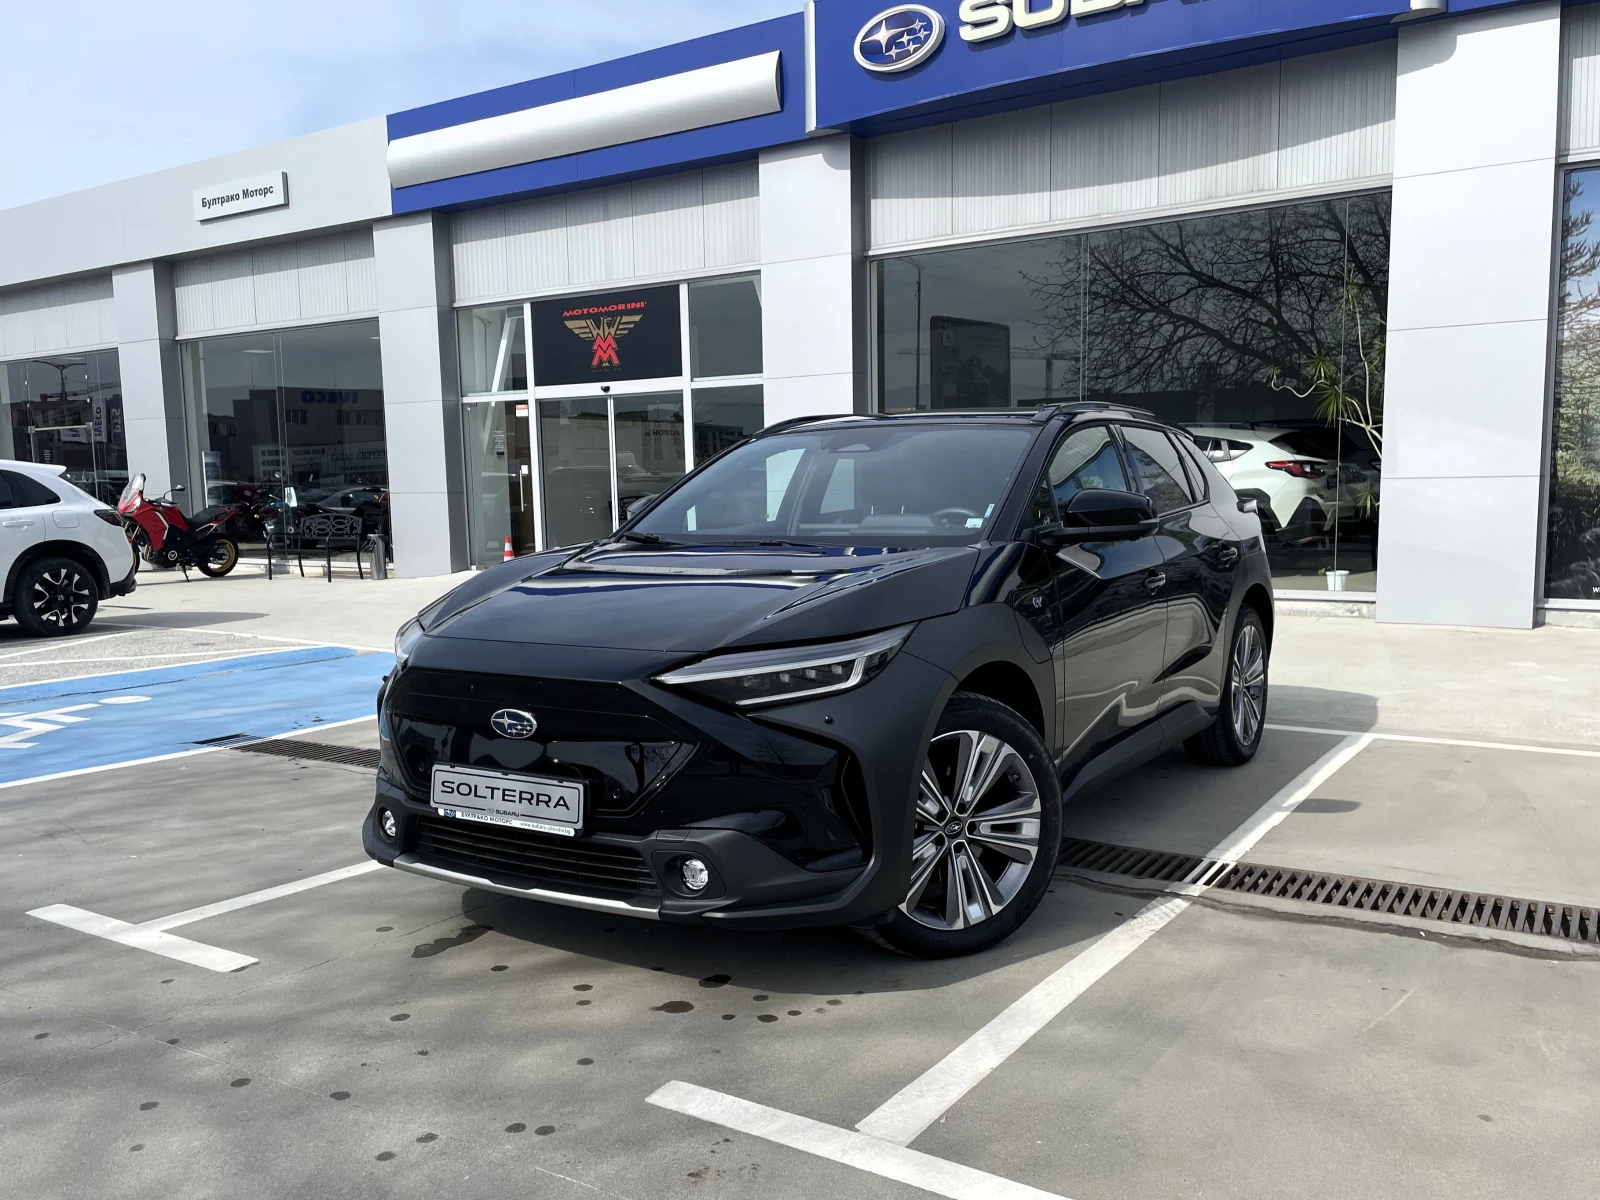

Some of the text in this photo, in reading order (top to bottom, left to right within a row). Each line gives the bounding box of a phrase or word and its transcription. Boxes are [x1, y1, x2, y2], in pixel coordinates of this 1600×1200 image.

[201, 185, 274, 209] Бултрако Моторс
[652, 429, 682, 437] HONDA
[440, 780, 571, 811] SOLTERRA
[495, 808, 520, 818] SUBARU
[489, 816, 513, 826] МОТОРС
